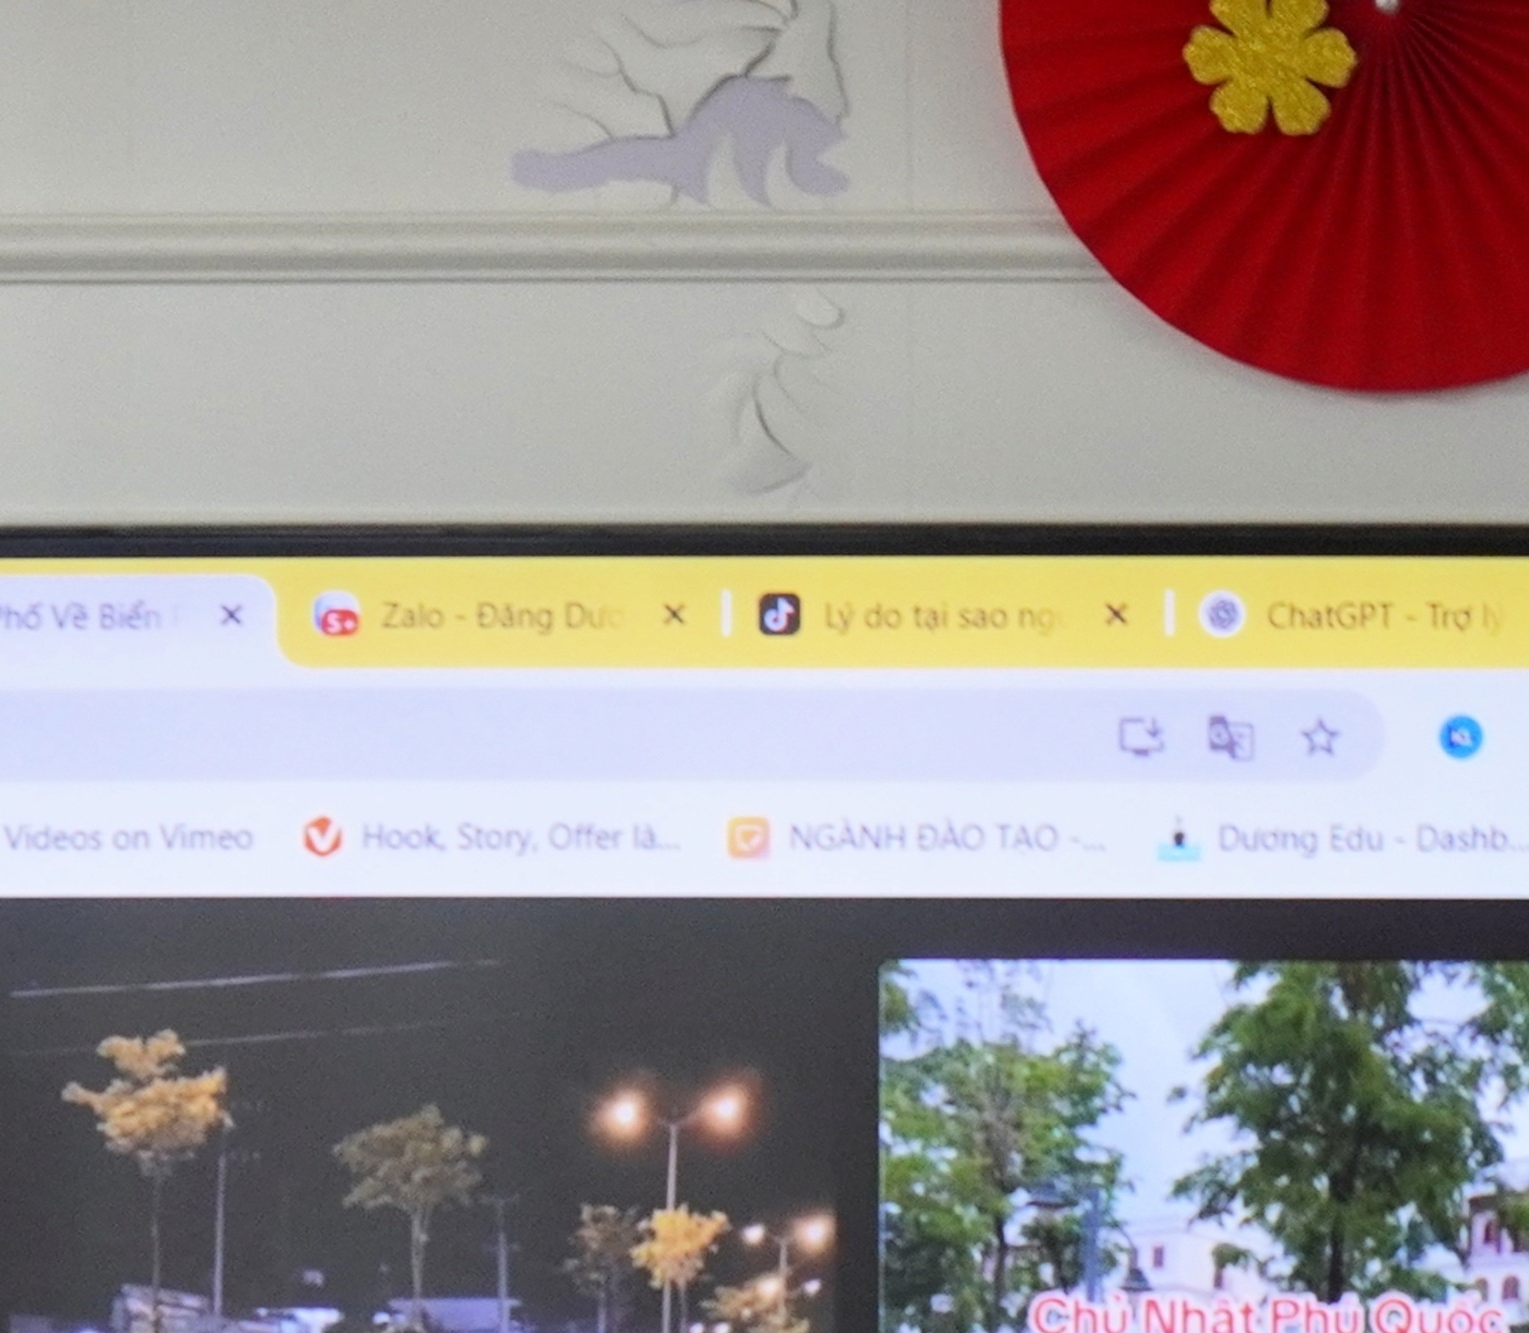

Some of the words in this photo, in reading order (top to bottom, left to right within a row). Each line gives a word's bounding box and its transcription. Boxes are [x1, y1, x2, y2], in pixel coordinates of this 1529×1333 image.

[51, 602, 89, 631] Về
[381, 602, 445, 629] Zalo
[824, 601, 855, 635] Lý
[864, 602, 903, 630] do
[912, 602, 949, 633] tại
[957, 606, 1009, 630] sao
[1266, 601, 1395, 630] ChatGPT
[3, 824, 103, 852] Videos
[112, 831, 150, 852] on
[158, 824, 254, 852] Vimeo
[549, 823, 623, 852] Offer
[789, 817, 906, 851] NGÀNH
[918, 817, 985, 851] ĐÀO
[1219, 823, 1318, 858] Dương
[1329, 823, 1384, 852] Edu
